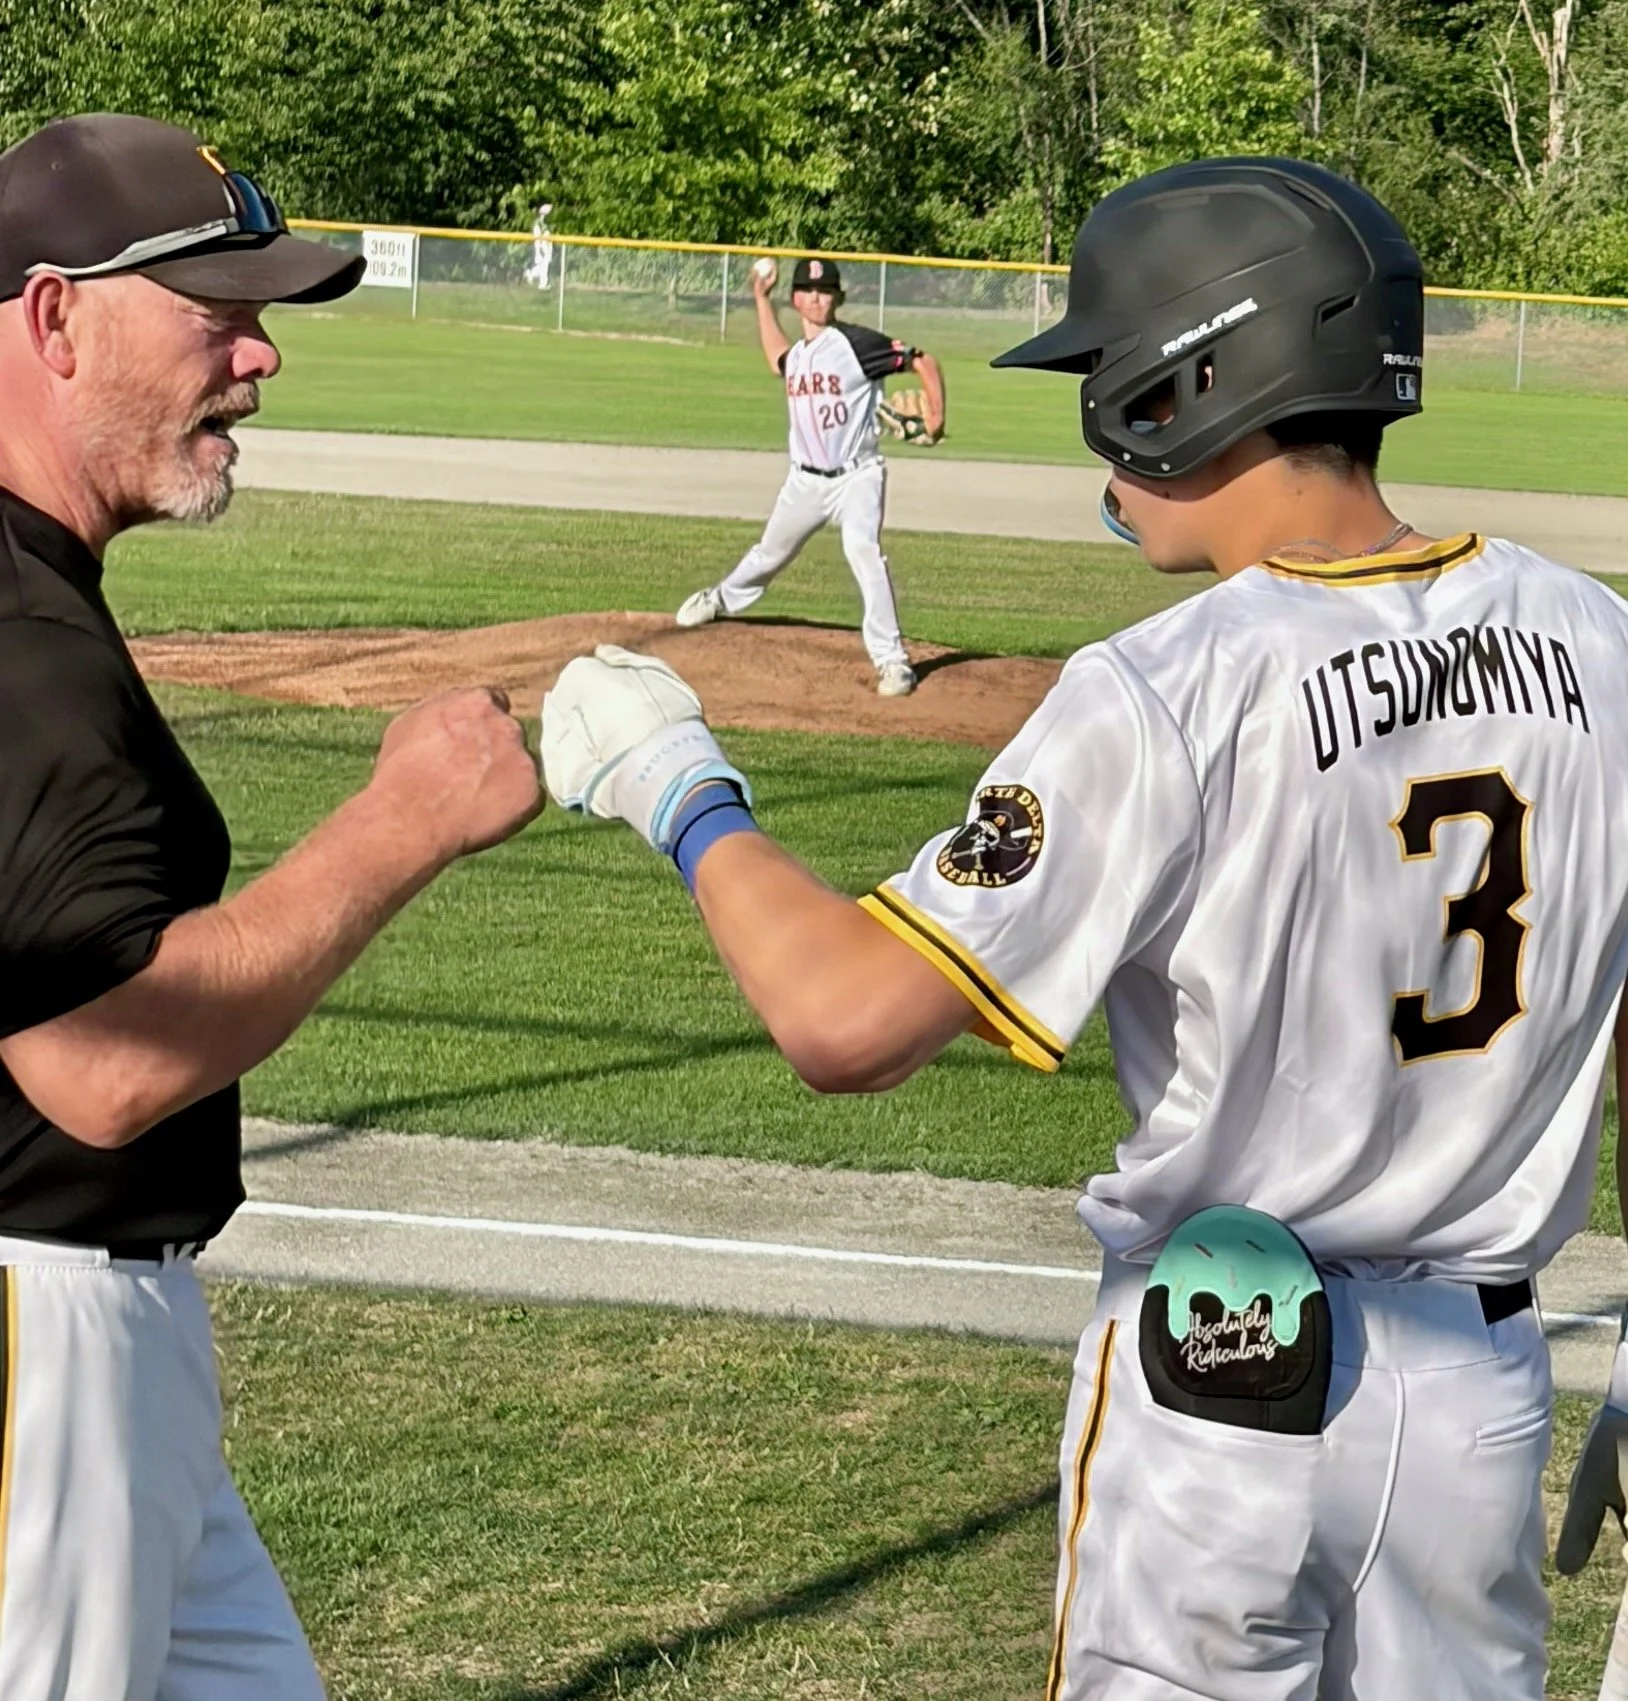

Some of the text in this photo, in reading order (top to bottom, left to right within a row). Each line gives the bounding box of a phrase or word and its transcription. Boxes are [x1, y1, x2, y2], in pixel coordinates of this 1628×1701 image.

[788, 371, 842, 396] EARS
[818, 400, 849, 430] 20
[1301, 624, 1591, 773] UTSUNOMIYA
[1387, 764, 1535, 1068] 3
[1188, 1299, 1271, 1343] Absolutely
[1180, 1333, 1279, 1372] Ridiculous
